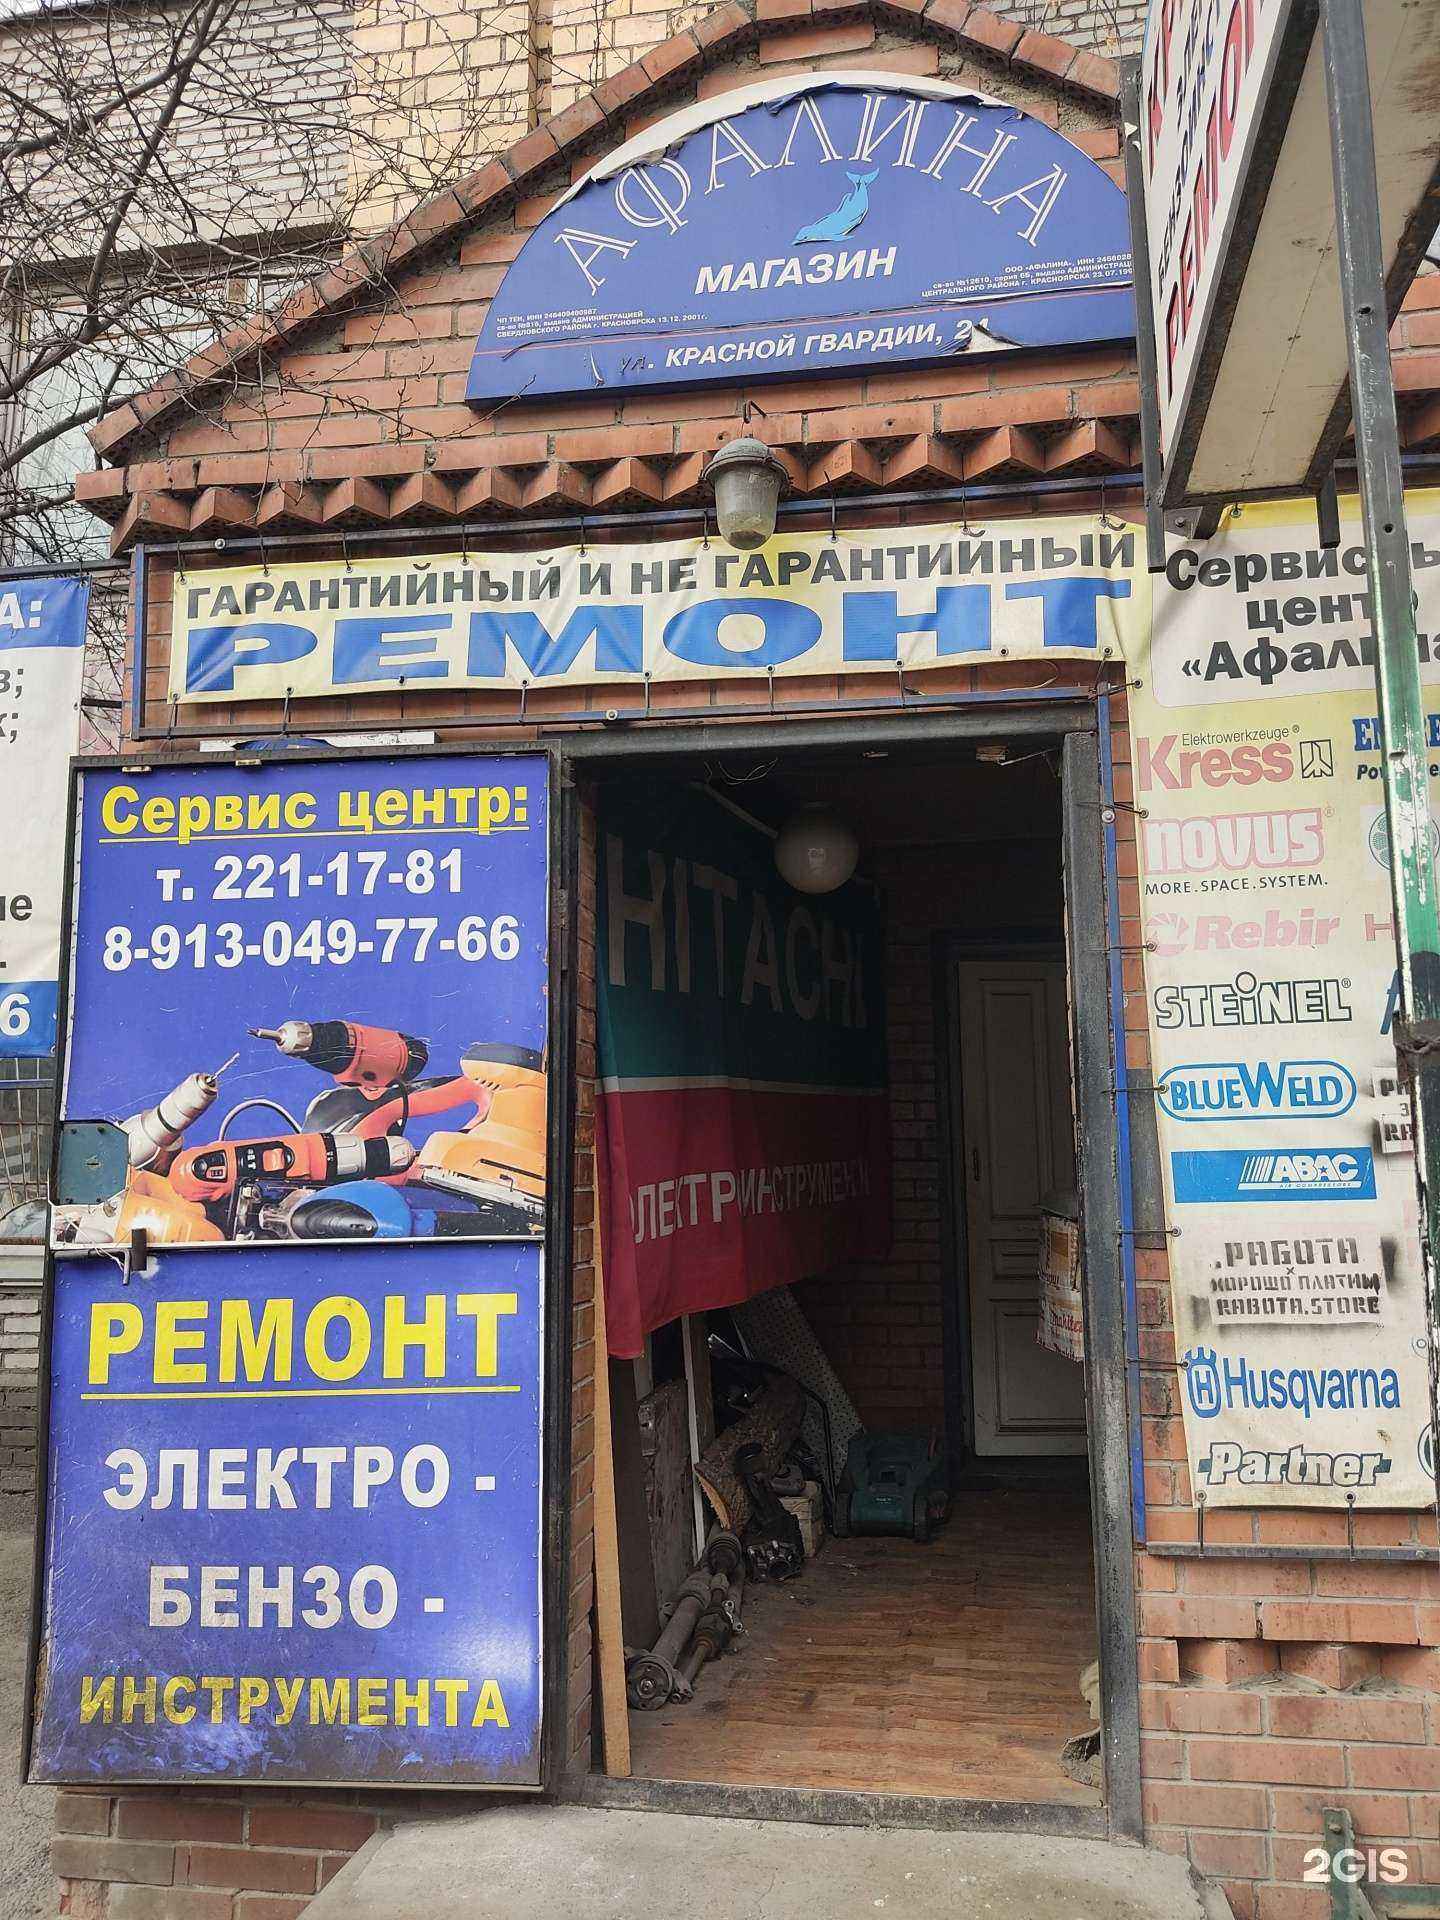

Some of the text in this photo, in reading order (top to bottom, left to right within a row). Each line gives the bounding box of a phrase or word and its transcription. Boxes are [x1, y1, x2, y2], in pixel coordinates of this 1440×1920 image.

[554, 93, 1070, 296] АФАЛИНА
[694, 246, 898, 297] МАГАЗИН
[986, 280, 1020, 290] РАЙОНА
[1030, 273, 1090, 286] КРАСНОЯРСКА
[665, 333, 797, 369] КРАСНОЙ
[803, 322, 943, 355] ГВАРДИИ,
[186, 517, 1135, 620] ГАРАНТИЙНЫЙ И НЕ ГАРАНТИЙНЫЙ
[186, 577, 1131, 694] РЕМОНТ
[1136, 735, 1294, 792] Kress
[1182, 727, 1289, 747] Elektrowerkzeuge
[101, 784, 528, 844] Сервис центр:
[155, 848, 462, 902] т. 221-17-81
[102, 915, 521, 972] 8-913-049-77-66
[606, 832, 867, 1030] HITACHI
[1194, 906, 1340, 951] Rebir
[1271, 1153, 1359, 1181] ABAC
[1210, 1272, 1381, 1295] ХОРОШО ПЛАТИМ
[1216, 1296, 1381, 1316] RABOTA.STORE
[88, 1292, 518, 1386] РЕМОНТ
[1222, 1357, 1401, 1419] Husqvarna
[102, 1443, 451, 1510] ЭЛЕКТРО
[1206, 1441, 1384, 1488] Partner
[148, 1563, 399, 1630] БЕНЗО
[79, 1675, 510, 1729] ИНСТРУМЕНТА
